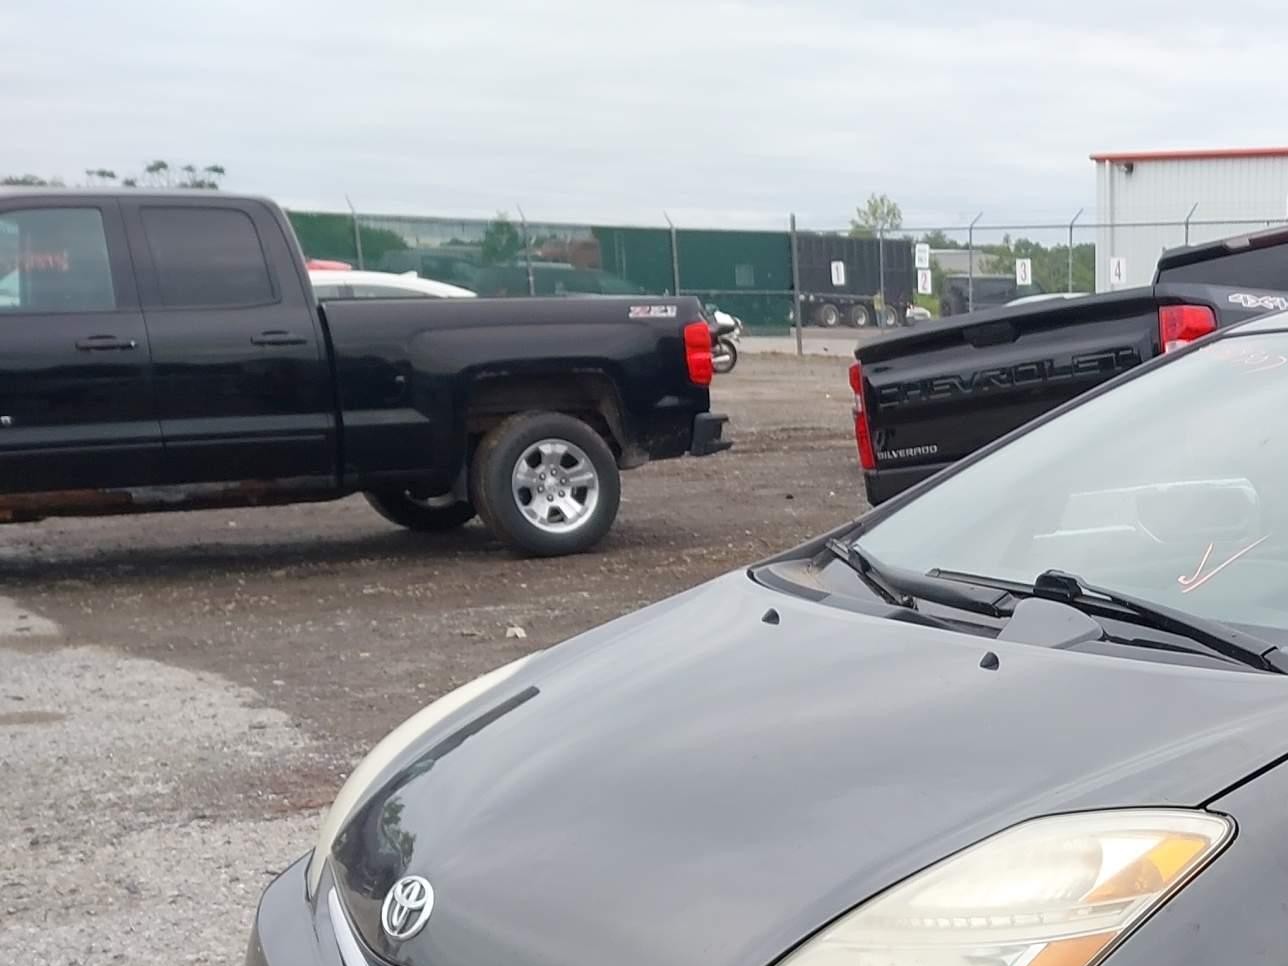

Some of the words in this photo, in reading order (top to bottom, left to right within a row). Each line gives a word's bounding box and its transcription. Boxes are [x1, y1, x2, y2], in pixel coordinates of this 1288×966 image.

[1114, 259, 1121, 281] 4
[878, 346, 1141, 408] CHEVROLET
[876, 444, 938, 461] SILVERADO
